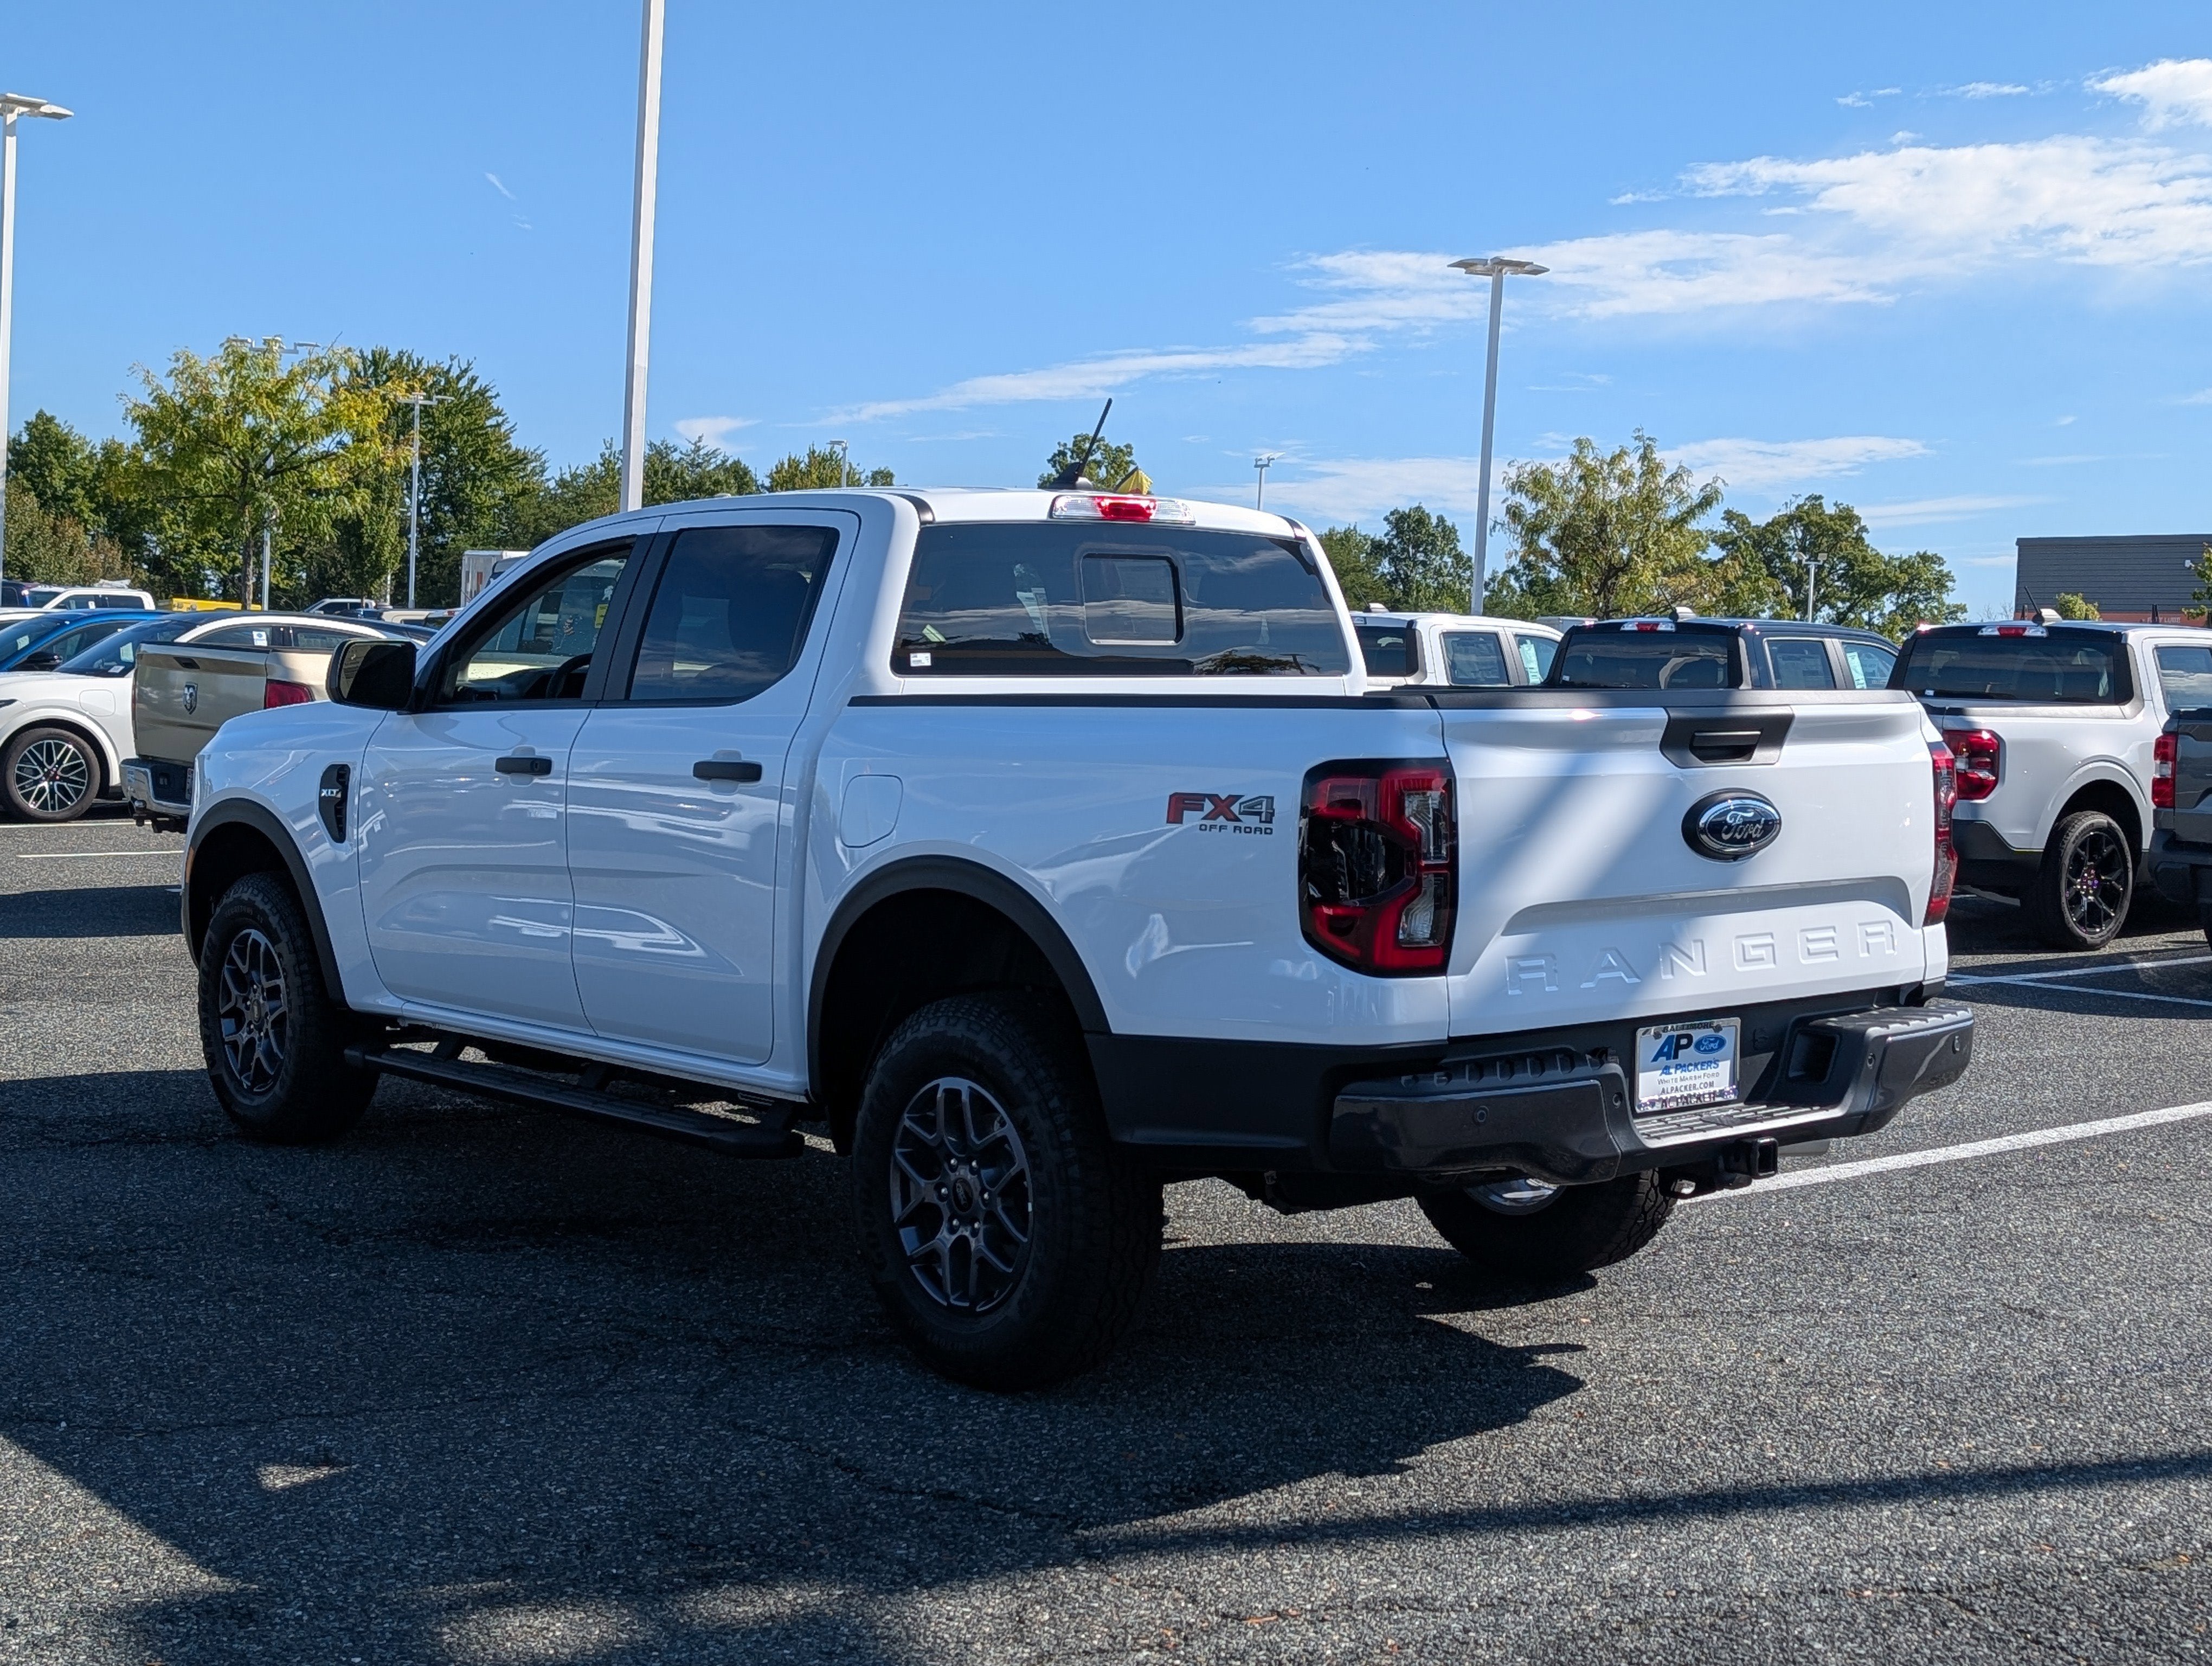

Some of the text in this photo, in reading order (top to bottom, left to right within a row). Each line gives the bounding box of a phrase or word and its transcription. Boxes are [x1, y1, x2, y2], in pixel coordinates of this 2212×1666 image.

[321, 789, 340, 797] XLT
[1167, 792, 1275, 824] FX4
[1199, 823, 1274, 835] OFF ROAD
[1721, 810, 1765, 840] Ford
[1505, 920, 1899, 996] RANGER
[1663, 1021, 1715, 1033] BALTIMORE
[1651, 1033, 1693, 1062] AP
[1659, 1058, 1720, 1076] AL PACKER'S
[1661, 1081, 1714, 1094] ALPACKER.COM
